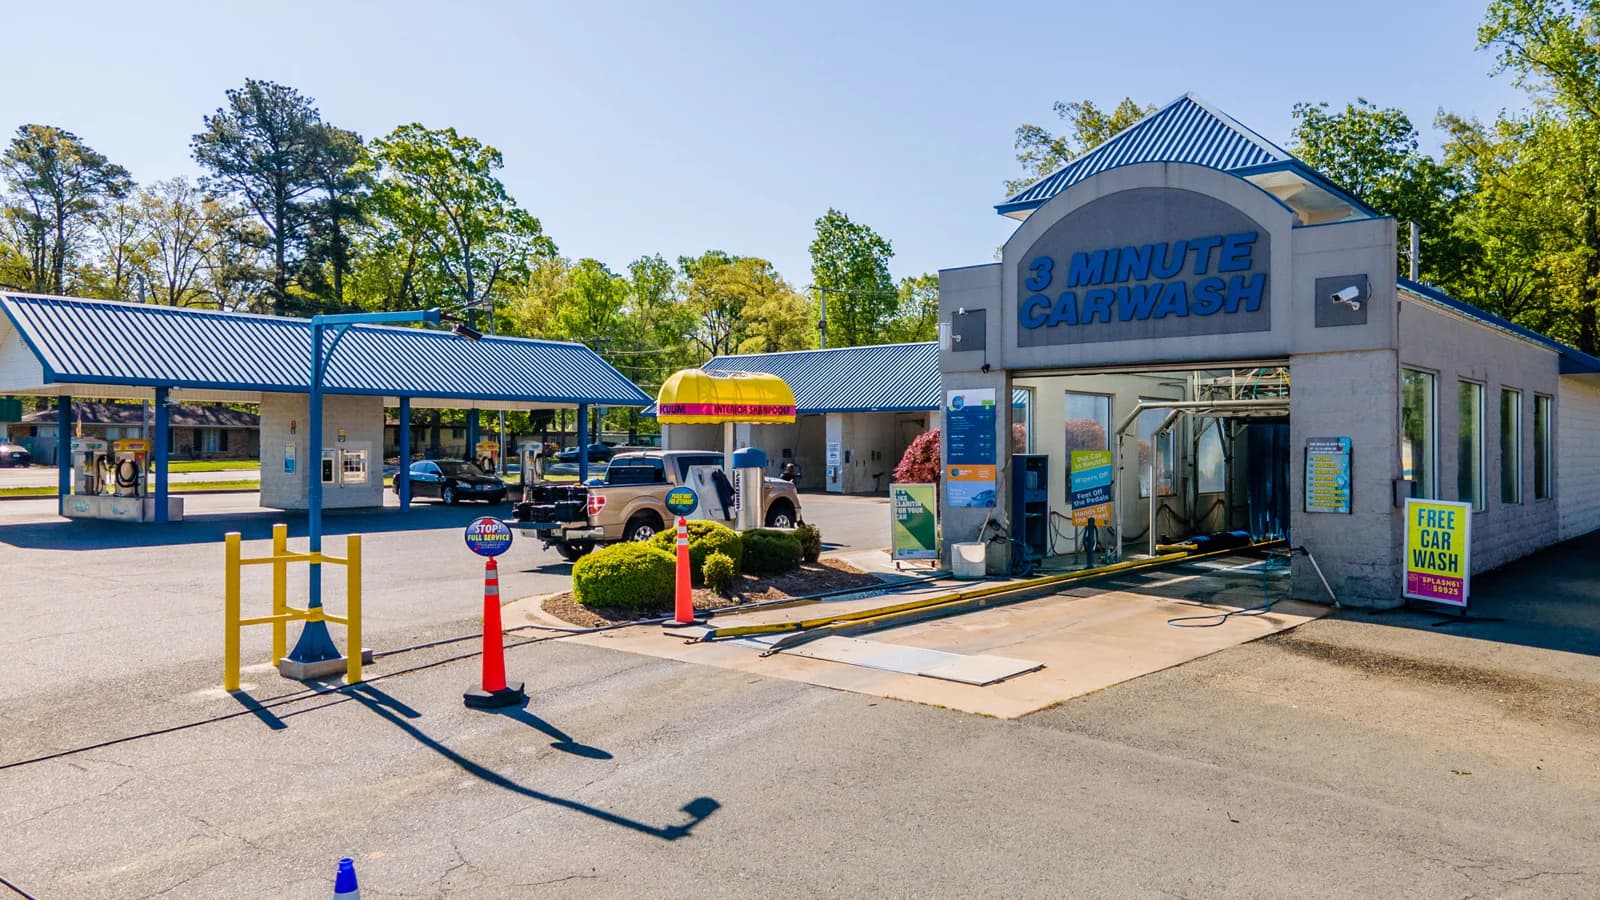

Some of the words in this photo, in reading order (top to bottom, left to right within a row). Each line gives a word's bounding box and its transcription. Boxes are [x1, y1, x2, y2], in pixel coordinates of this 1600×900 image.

[1024, 256, 1055, 293] 3
[1066, 231, 1258, 289] MINUTE
[1019, 272, 1267, 330] CARWASH
[714, 405, 747, 415] INTERIOR
[1086, 495, 1109, 504] Pedals
[1092, 488, 1102, 496] Off
[475, 524, 502, 534] STOP!
[1417, 508, 1456, 530] FREE
[1420, 529, 1452, 550] CAR
[1413, 549, 1458, 572] WASH
